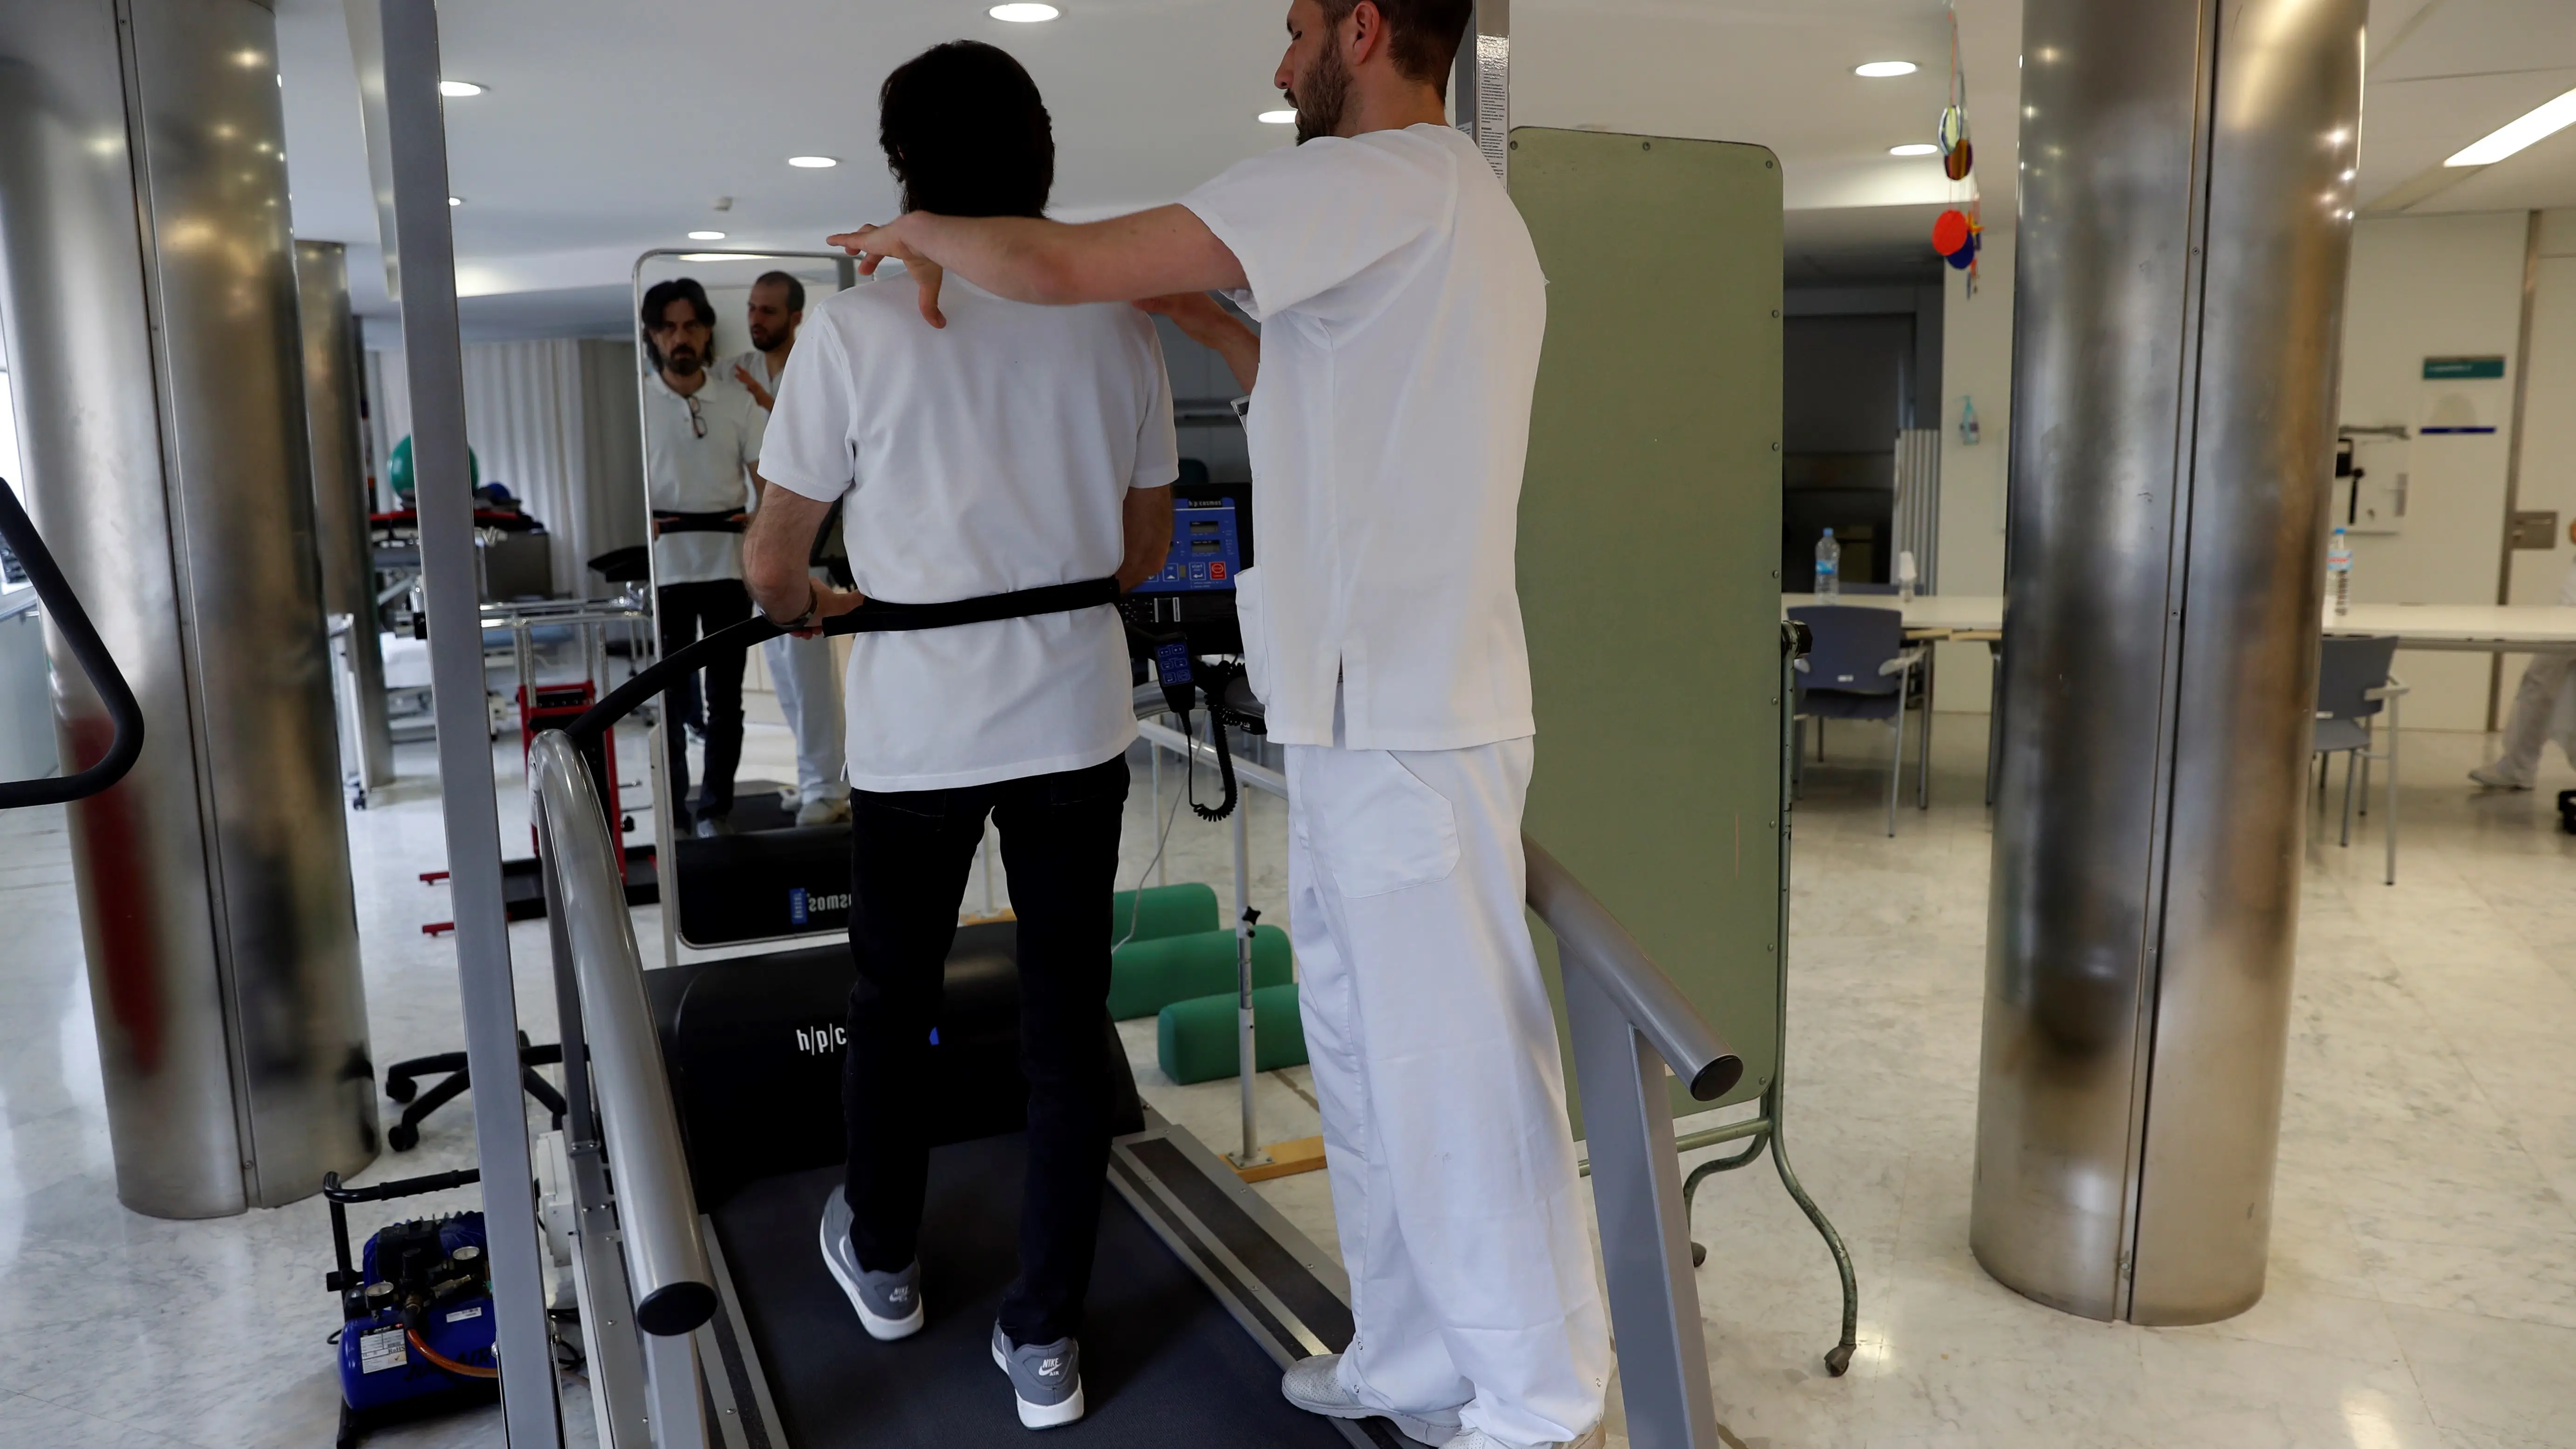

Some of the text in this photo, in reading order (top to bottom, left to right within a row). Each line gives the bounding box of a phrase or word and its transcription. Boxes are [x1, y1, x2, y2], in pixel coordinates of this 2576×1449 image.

[796, 1023, 847, 1055] h/p/c
[894, 1285, 909, 1295] NIKE
[1043, 1358, 1059, 1368] NIKE
